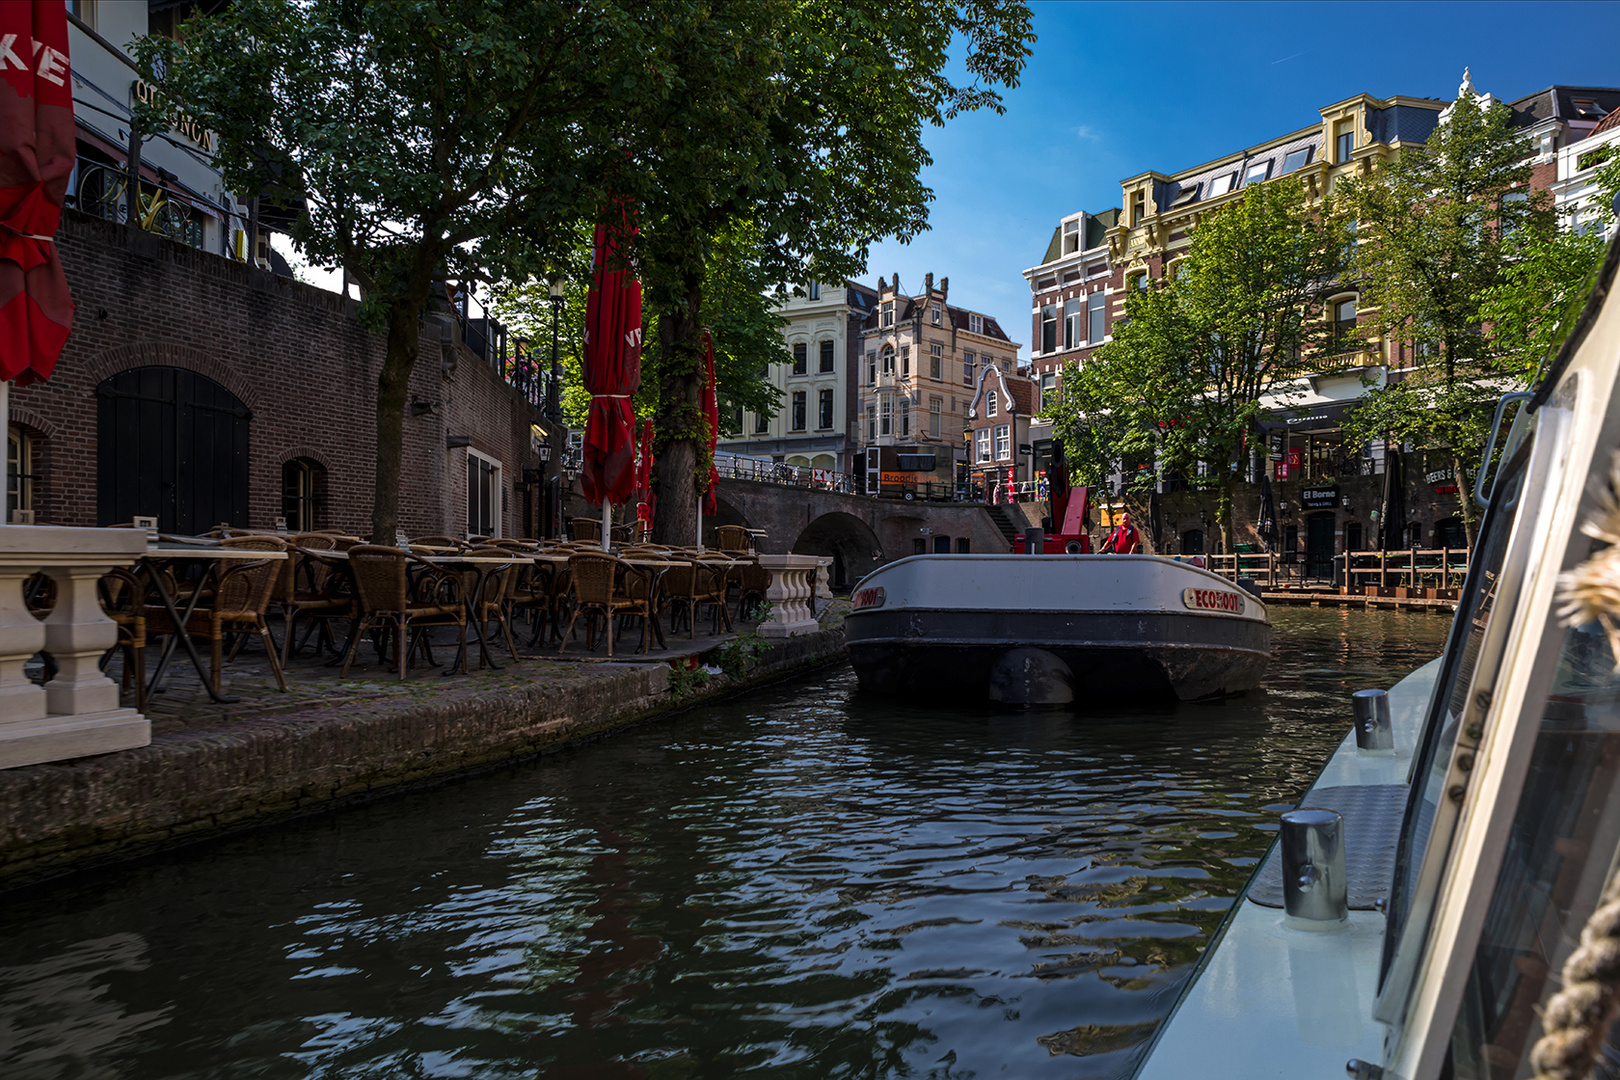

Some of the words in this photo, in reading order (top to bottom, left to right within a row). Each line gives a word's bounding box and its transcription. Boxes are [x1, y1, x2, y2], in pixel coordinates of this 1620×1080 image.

[884, 474, 918, 484] Broodje
[921, 474, 938, 482] Ben
[1425, 469, 1446, 484] BEERS
[1303, 490, 1311, 499] El
[1312, 490, 1336, 499] Borne
[1195, 589, 1238, 612] ECOBOOT
